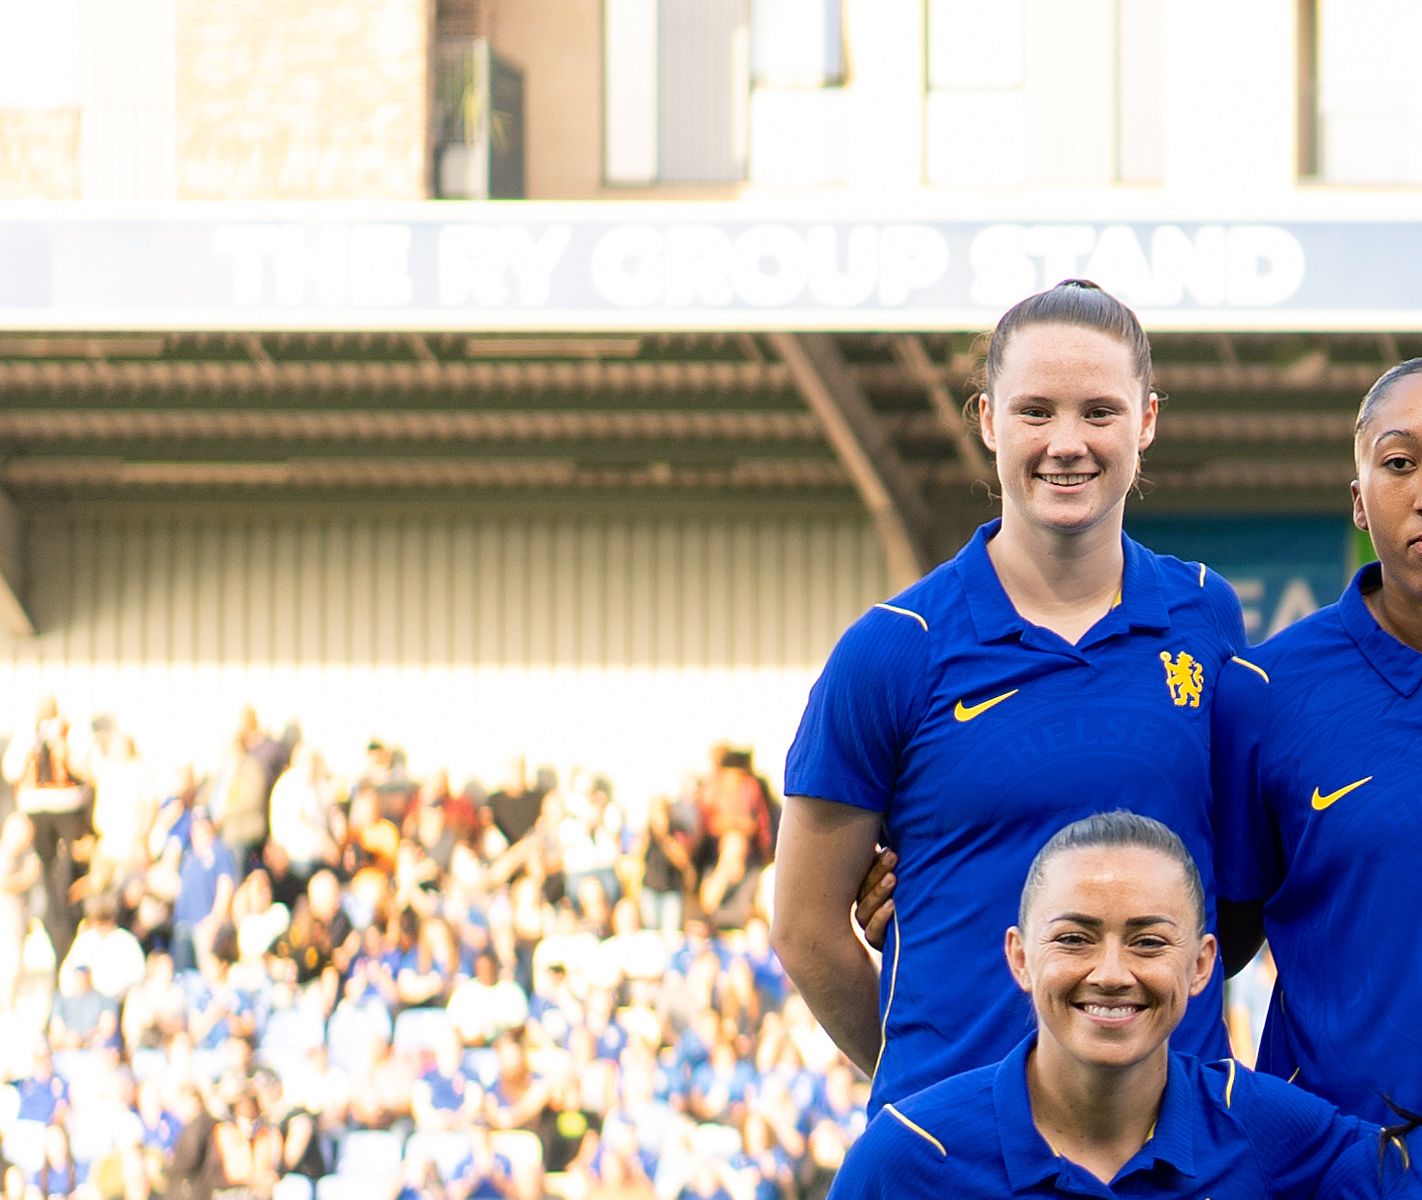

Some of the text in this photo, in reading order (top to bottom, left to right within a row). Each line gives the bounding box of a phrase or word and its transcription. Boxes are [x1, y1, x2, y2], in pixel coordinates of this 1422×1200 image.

[437, 222, 572, 306] RY
[591, 222, 948, 307] GROUP
[968, 222, 1306, 307] STAND
